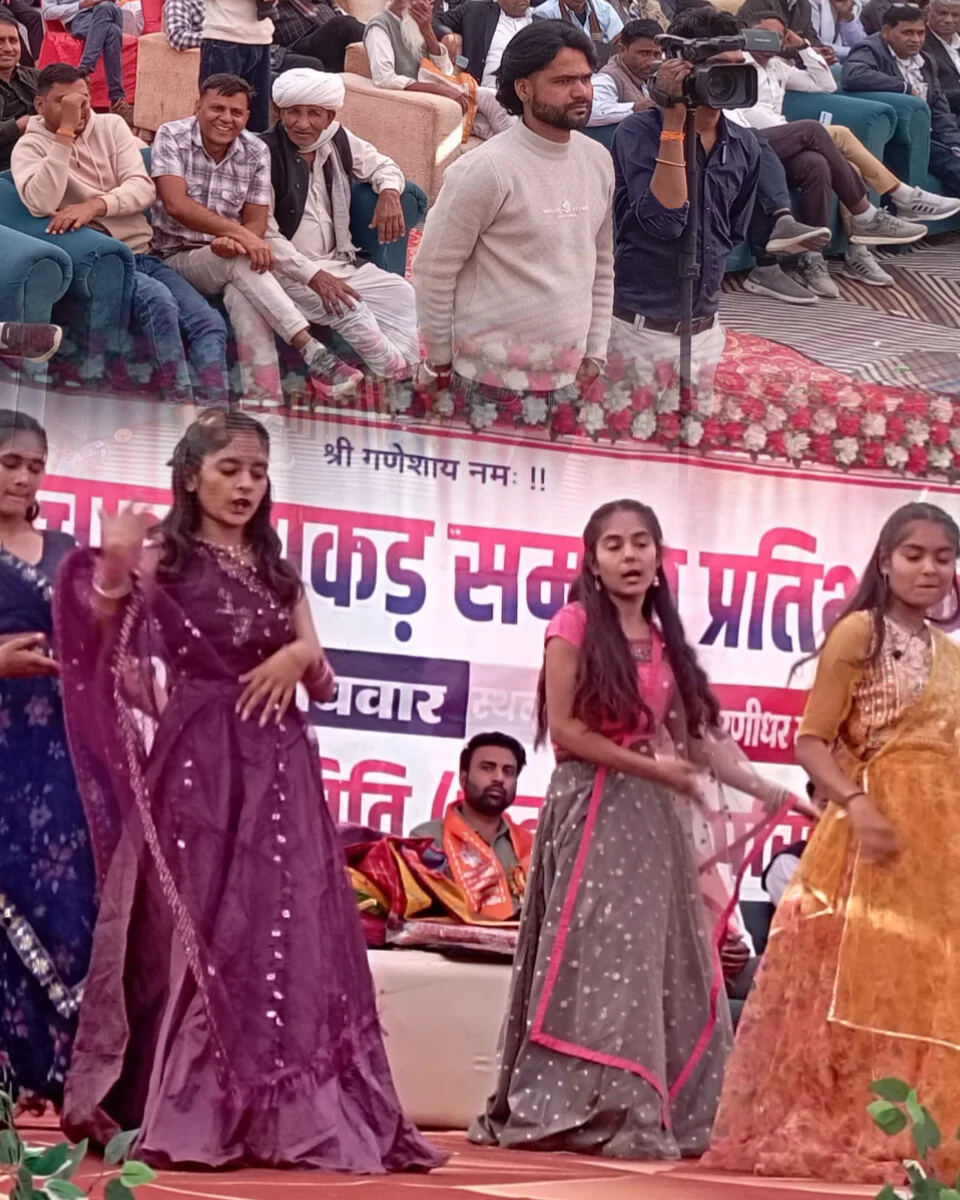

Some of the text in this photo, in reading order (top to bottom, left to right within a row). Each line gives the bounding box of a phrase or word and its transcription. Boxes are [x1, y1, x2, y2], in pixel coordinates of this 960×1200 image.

[323, 436, 353, 469] श्री
[363, 443, 459, 482] गणेशाय
[468, 460, 518, 487] नमः
